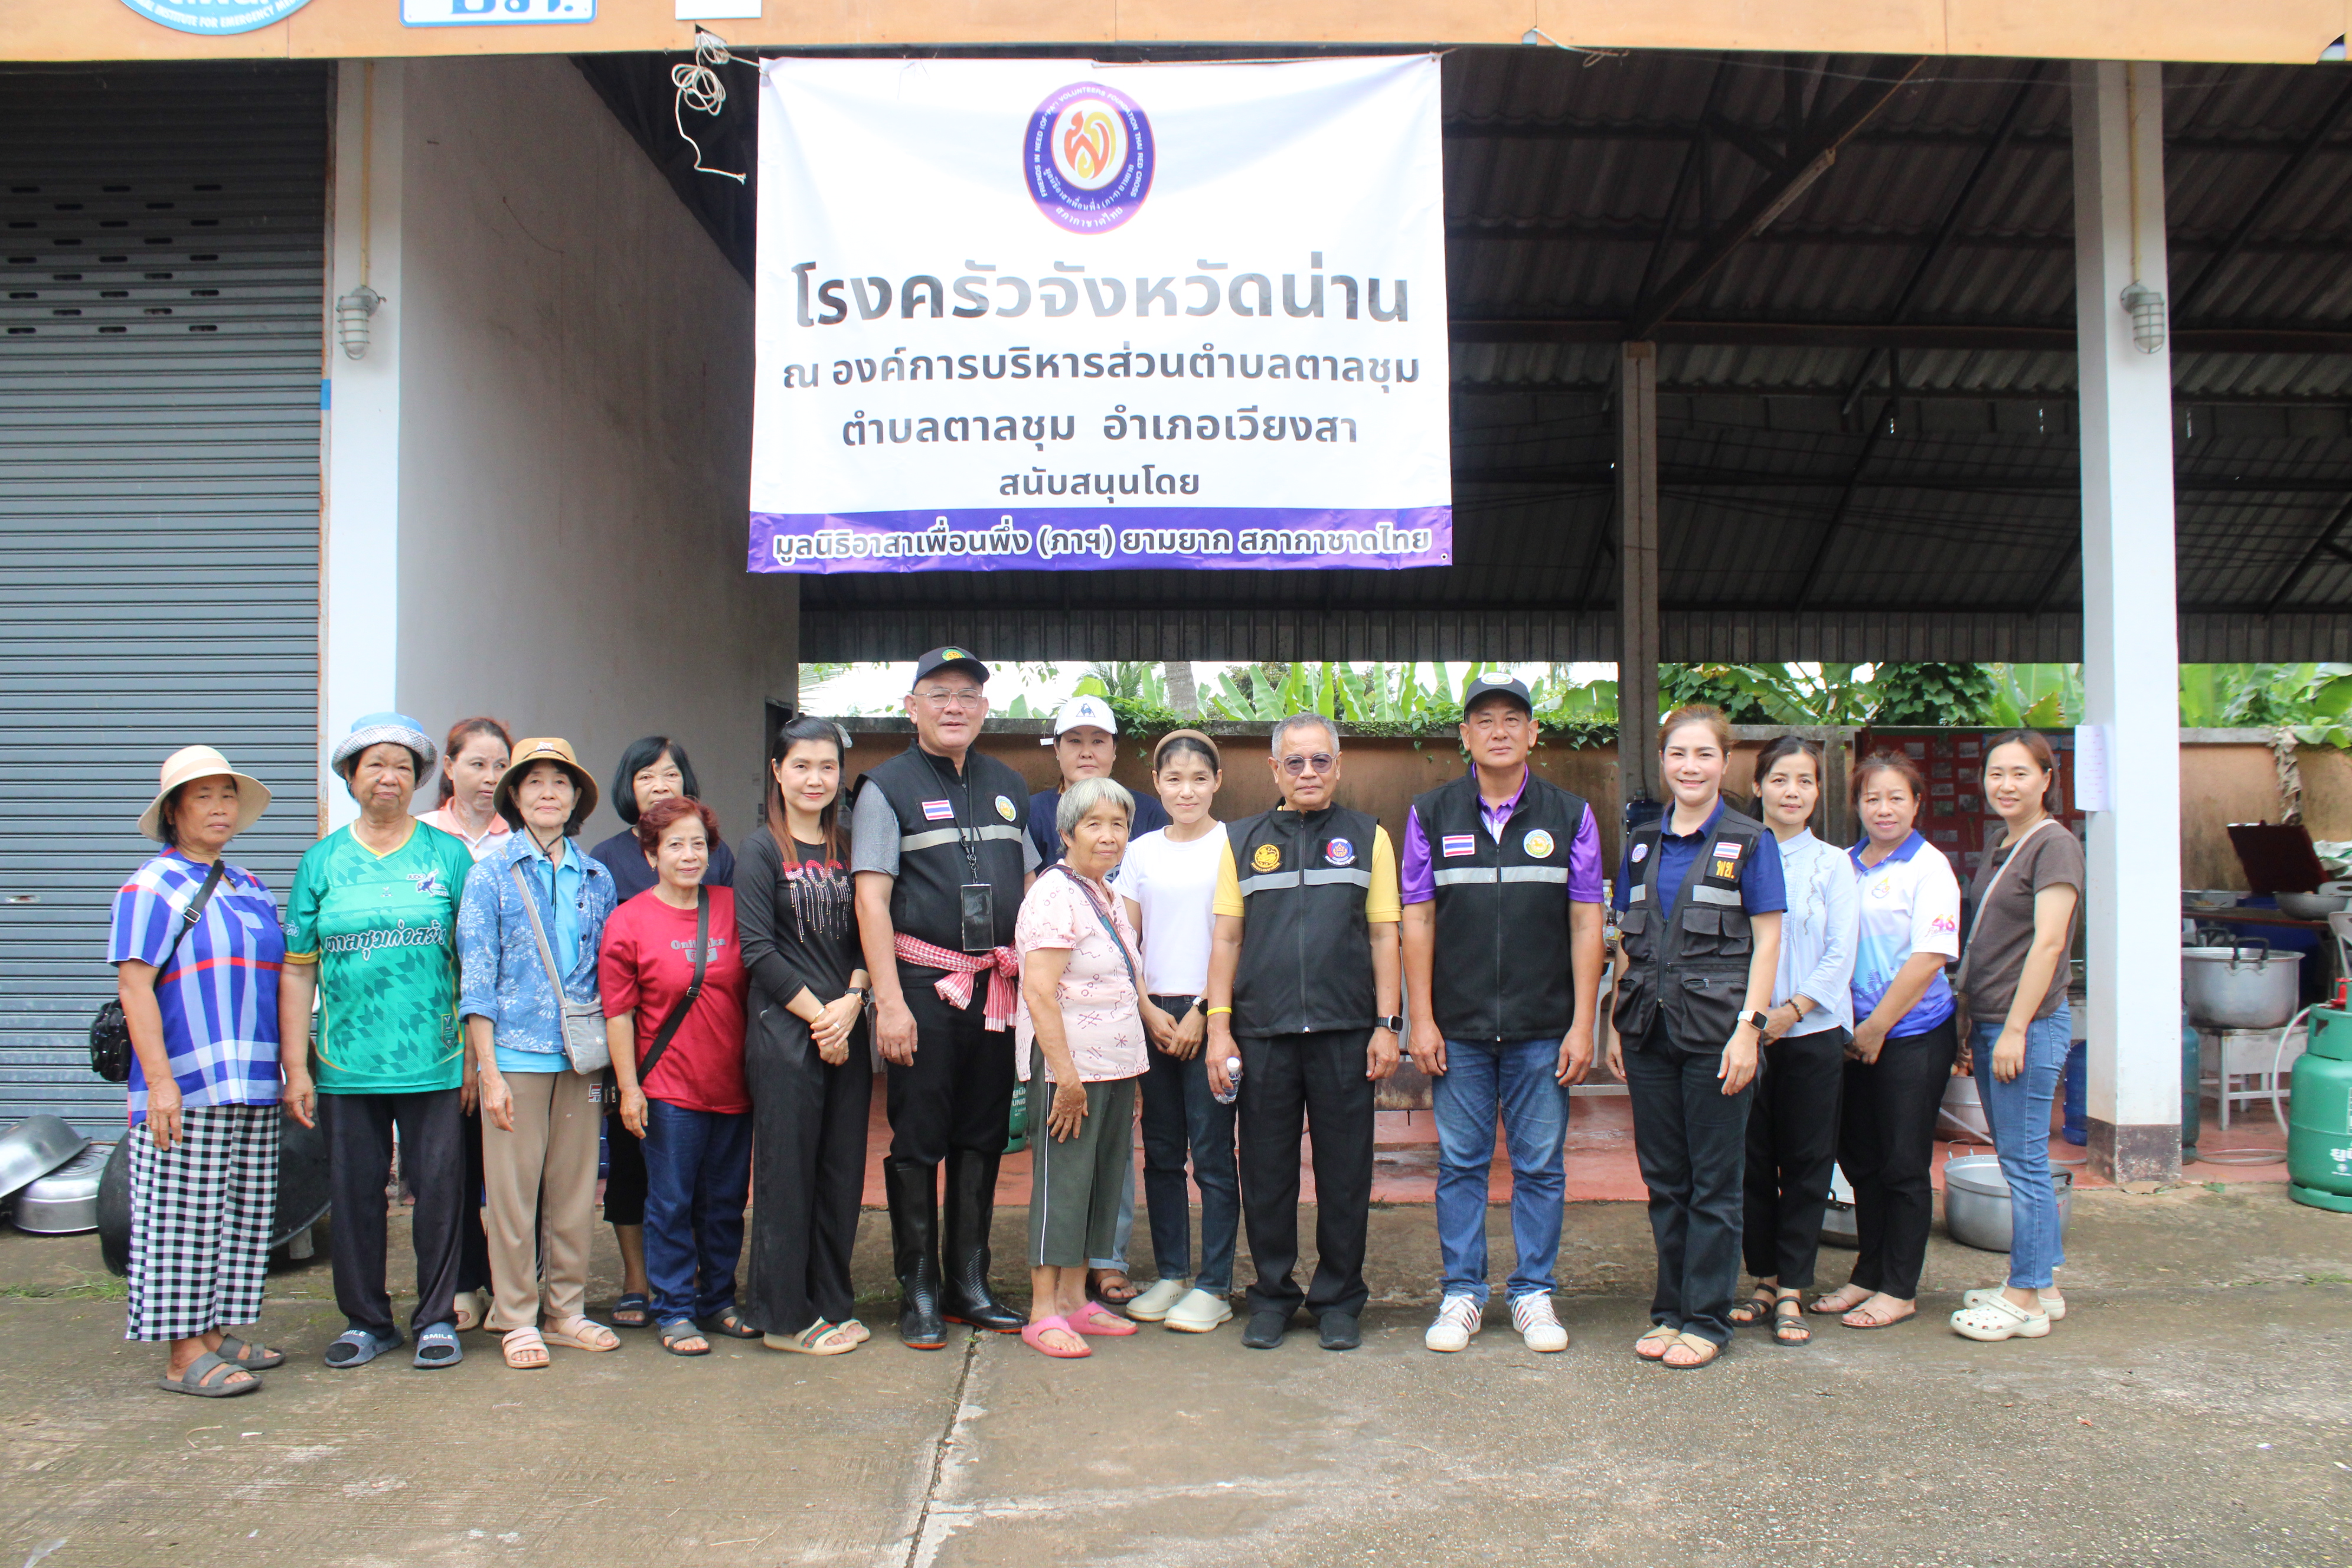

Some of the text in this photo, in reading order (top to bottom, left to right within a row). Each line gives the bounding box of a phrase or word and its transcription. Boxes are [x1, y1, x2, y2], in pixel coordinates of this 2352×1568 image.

[220, 5, 275, 28] EMERGENCY
[1058, 87, 1106, 102] VOLUNTEERS
[1108, 93, 1139, 131] FOUNDATION
[1035, 130, 1044, 152] NEED
[1135, 132, 1143, 151] THAI
[1034, 154, 1040, 163] IN
[1035, 165, 1048, 198] FRIENDS
[1130, 171, 1142, 198] CROSS
[1056, 206, 1123, 228] สภากาชาดไทย
[791, 251, 1409, 328] โรงครัวจังหวัดน่าน
[783, 341, 1419, 394] ณ องค์การบริหารส่วนตำบลตาลชุม
[842, 404, 1357, 452] ตำบลตาลชุม อำเภอเวียงสา
[999, 463, 1200, 504] สนับสนุนโดย
[774, 517, 1031, 564] มูลนิธิอาสาเพื่อนพึ่ง
[1122, 530, 1232, 554] ยามยาก
[1240, 522, 1431, 554] สภากาชาดไทย
[782, 859, 851, 888] ROC
[1931, 914, 1955, 932] 46
[325, 919, 446, 961] ตาลชุมก่อสร้าง
